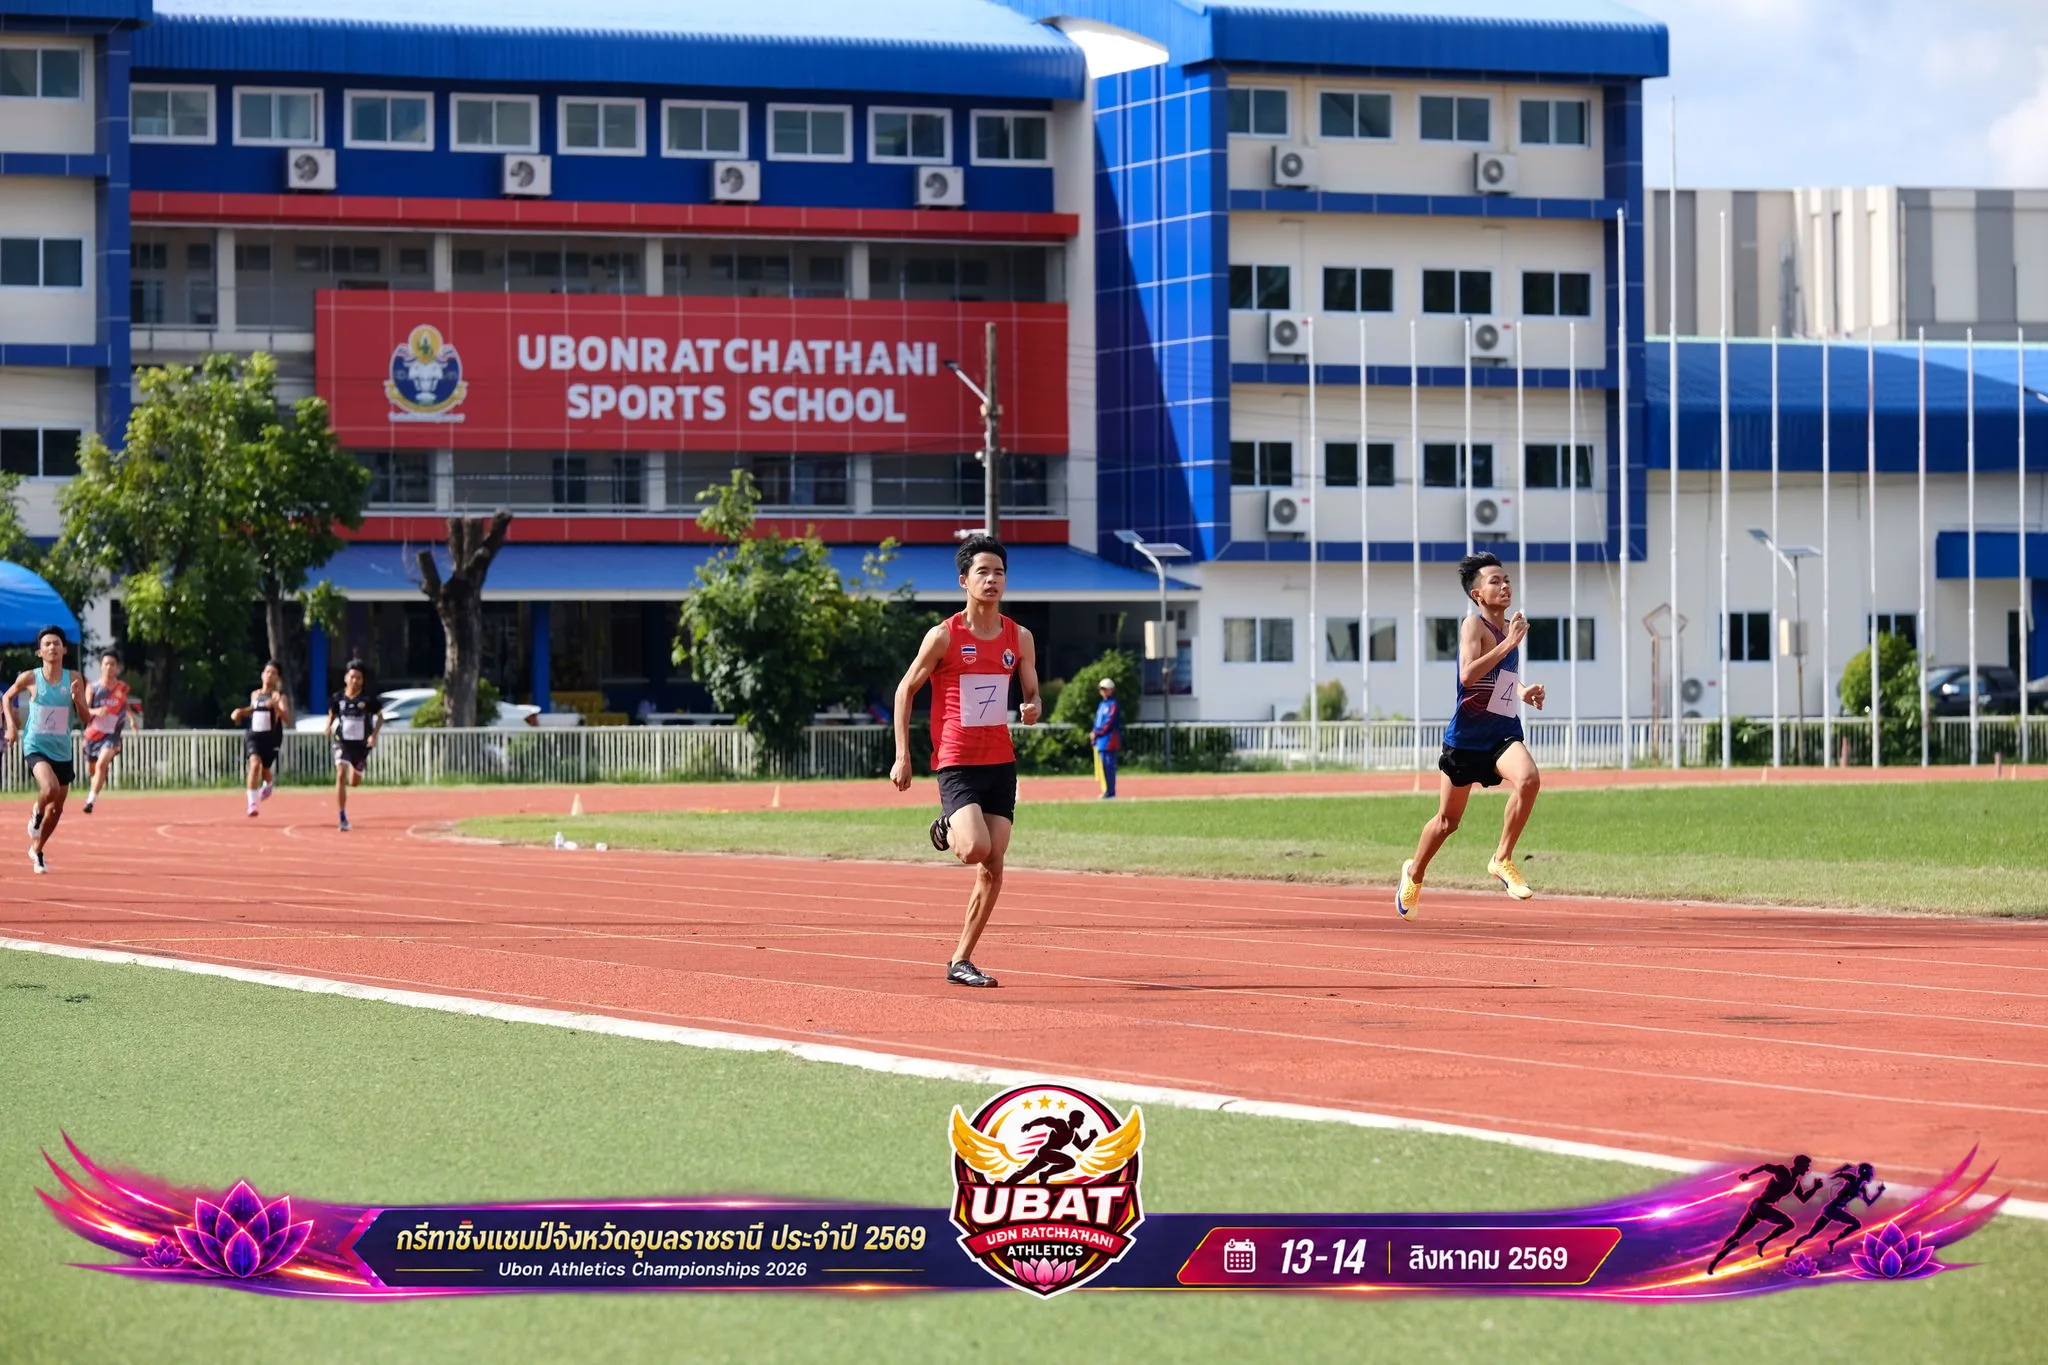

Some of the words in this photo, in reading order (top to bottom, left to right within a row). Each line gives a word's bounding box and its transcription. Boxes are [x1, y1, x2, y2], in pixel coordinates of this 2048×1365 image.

[518, 335, 937, 376] UBONRATCHATHANI
[567, 384, 726, 421] SPORTS
[748, 387, 907, 423] SCHOOL
[975, 685, 997, 719] 7
[1501, 682, 1513, 707] 4
